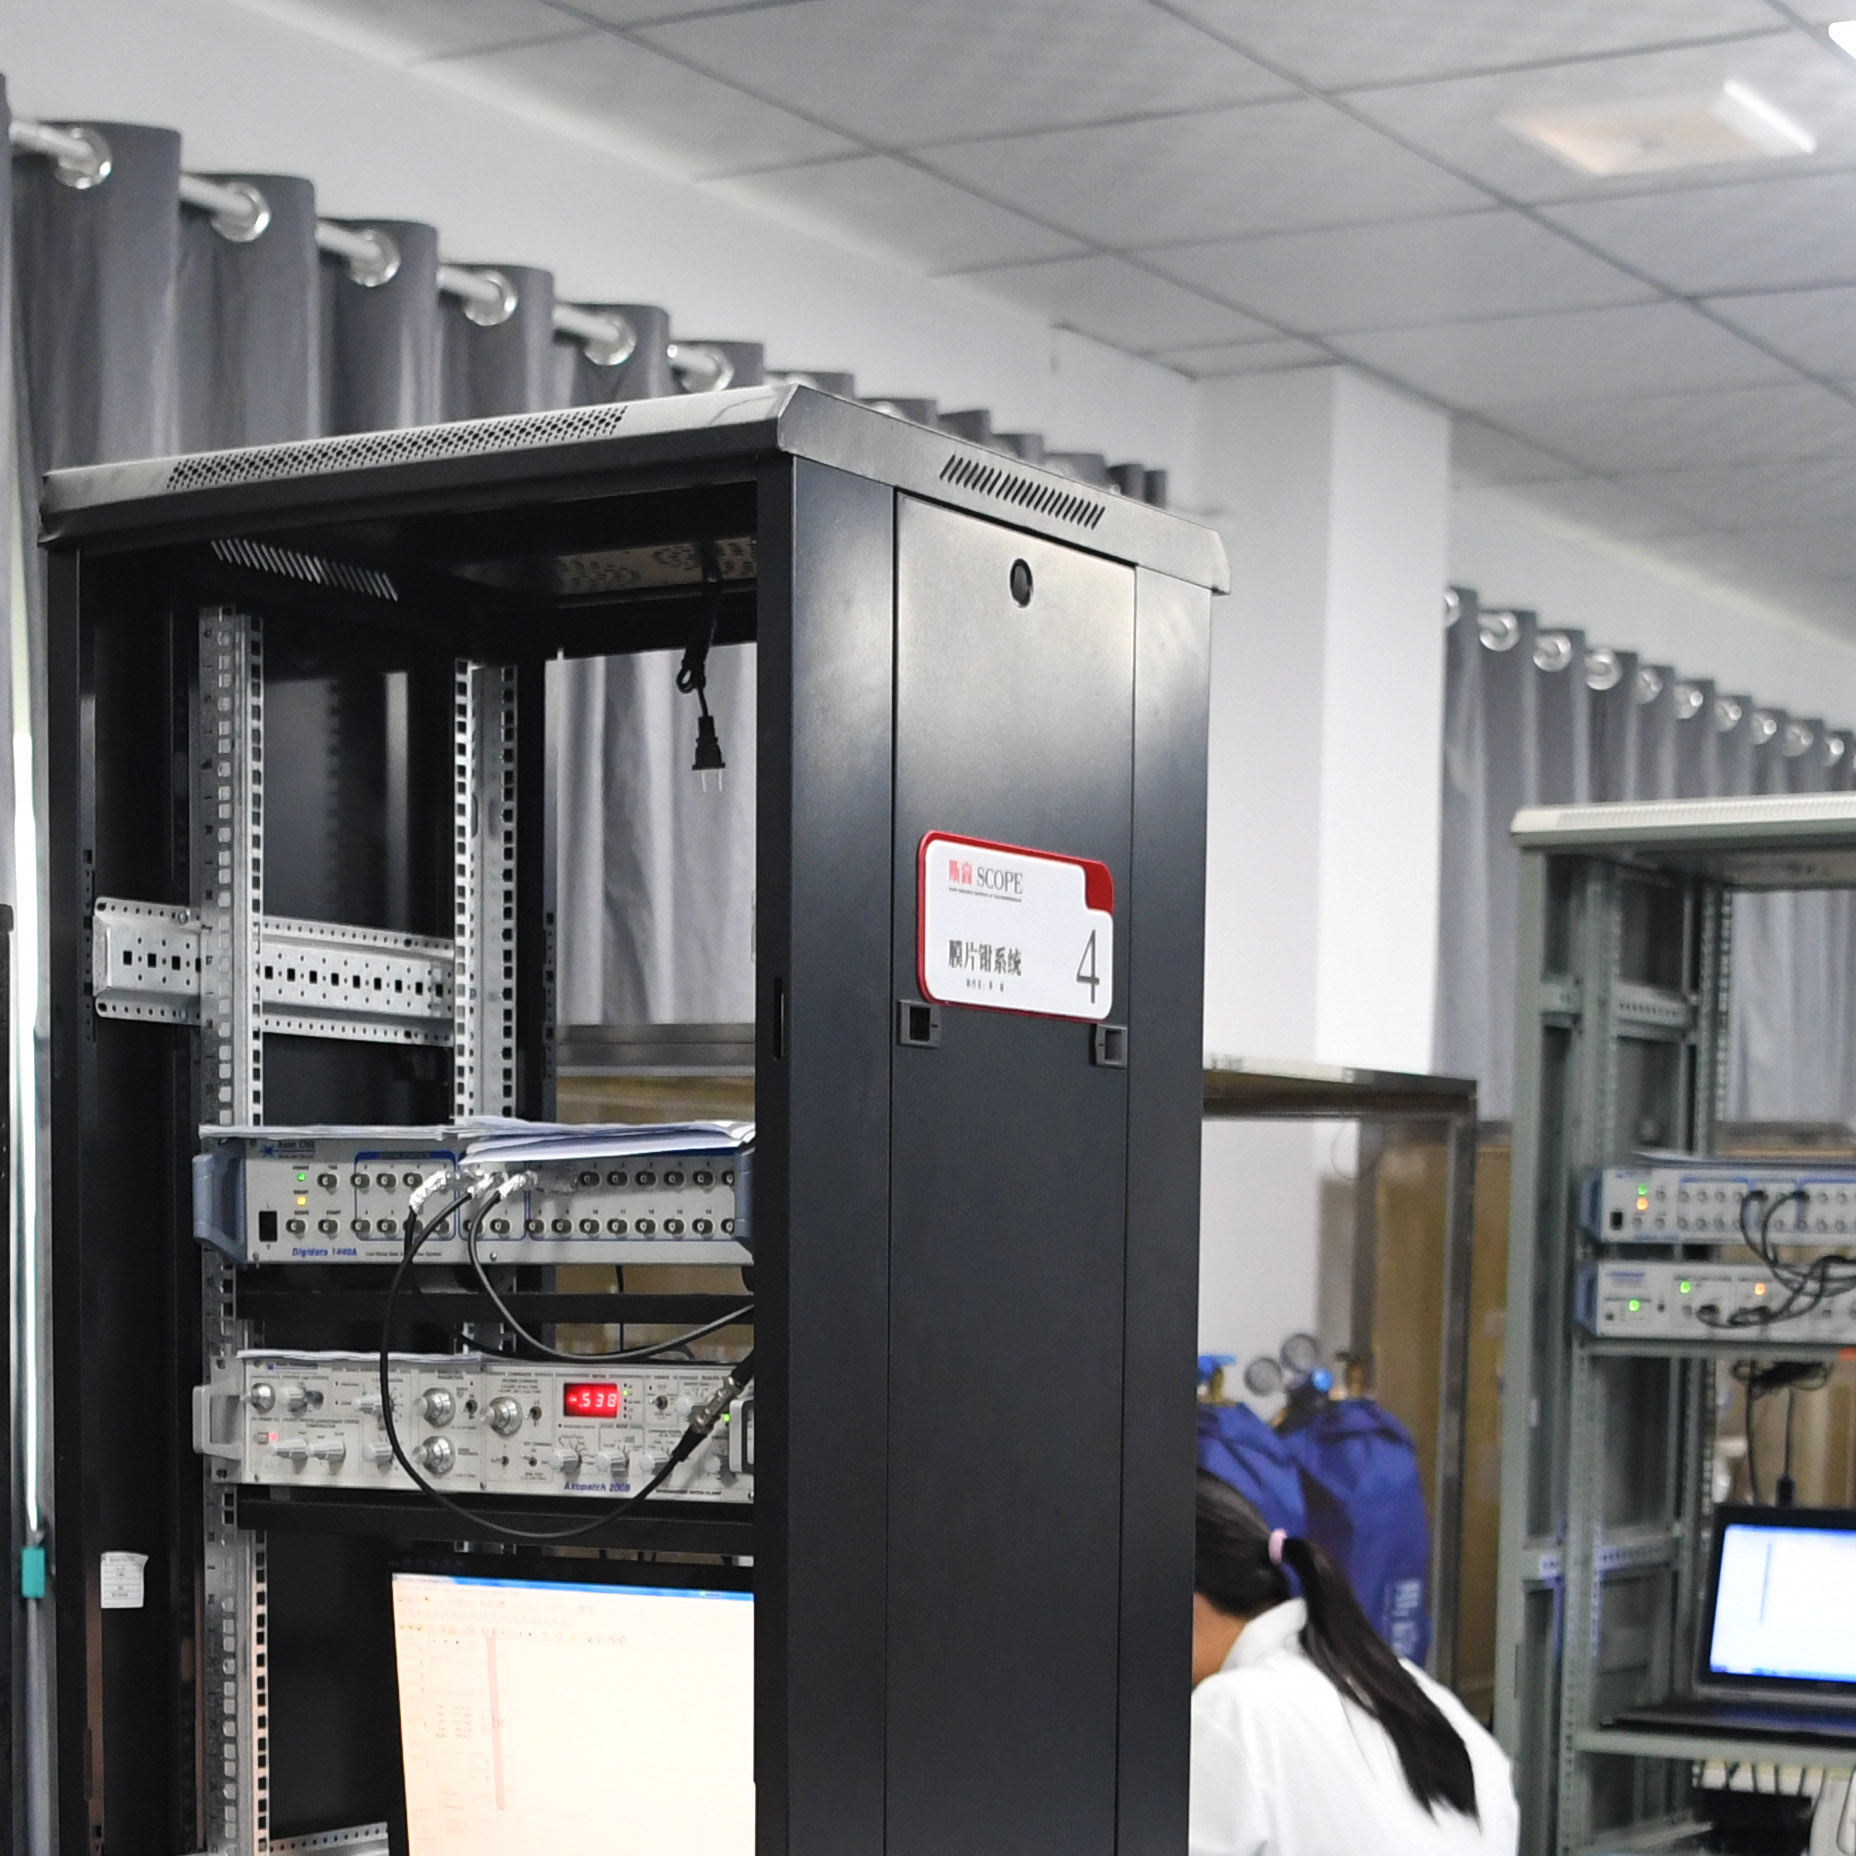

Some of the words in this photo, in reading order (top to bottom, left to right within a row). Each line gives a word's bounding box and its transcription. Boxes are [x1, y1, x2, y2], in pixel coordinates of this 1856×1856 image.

[976, 866, 1024, 895] SCOPE
[947, 939, 1022, 977] 膜片钳系统
[1075, 928, 1101, 1004] 4
[563, 1481, 607, 1492] Axopatch
